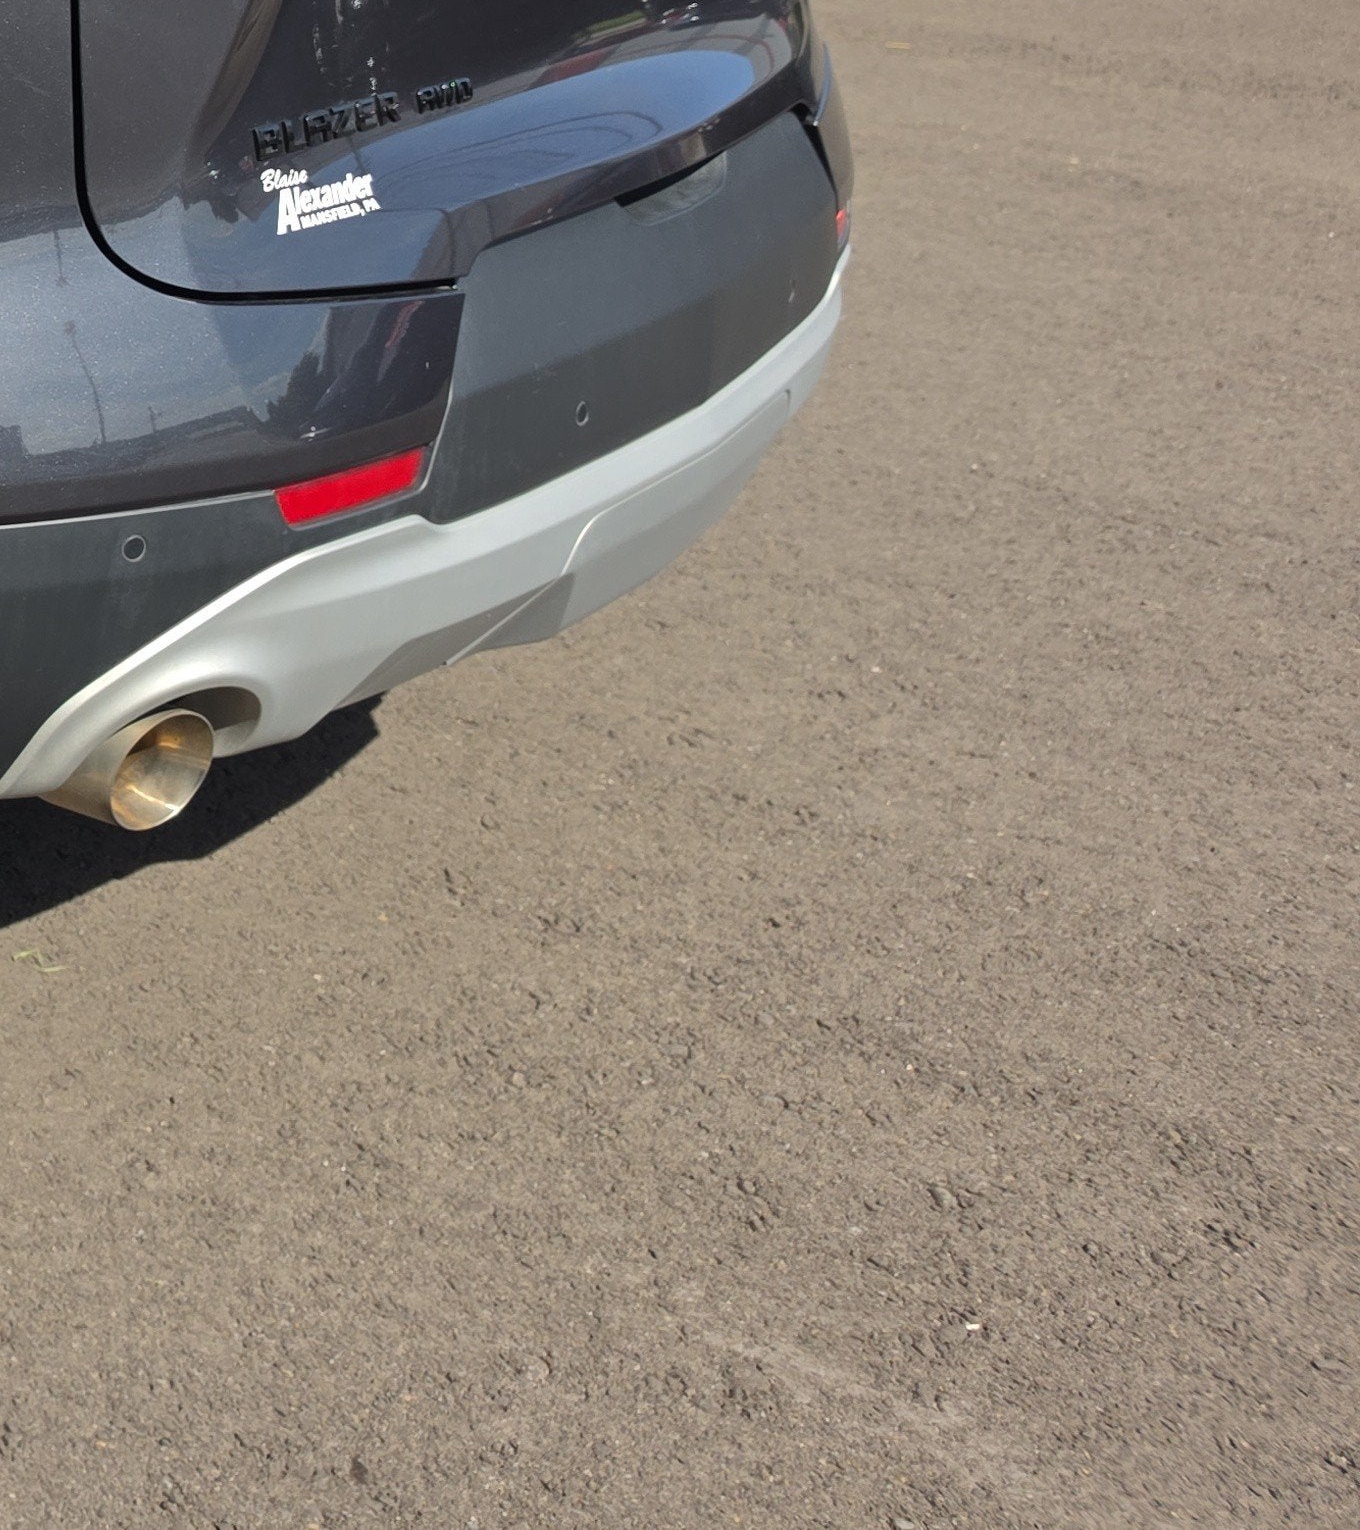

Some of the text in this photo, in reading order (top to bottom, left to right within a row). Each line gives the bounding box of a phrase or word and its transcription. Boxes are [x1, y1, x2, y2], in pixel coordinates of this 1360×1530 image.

[251, 91, 402, 162] BLAZER
[260, 168, 308, 193] Blaise
[276, 172, 374, 236] Alexander
[299, 197, 381, 230] MANSFIELD, PA
